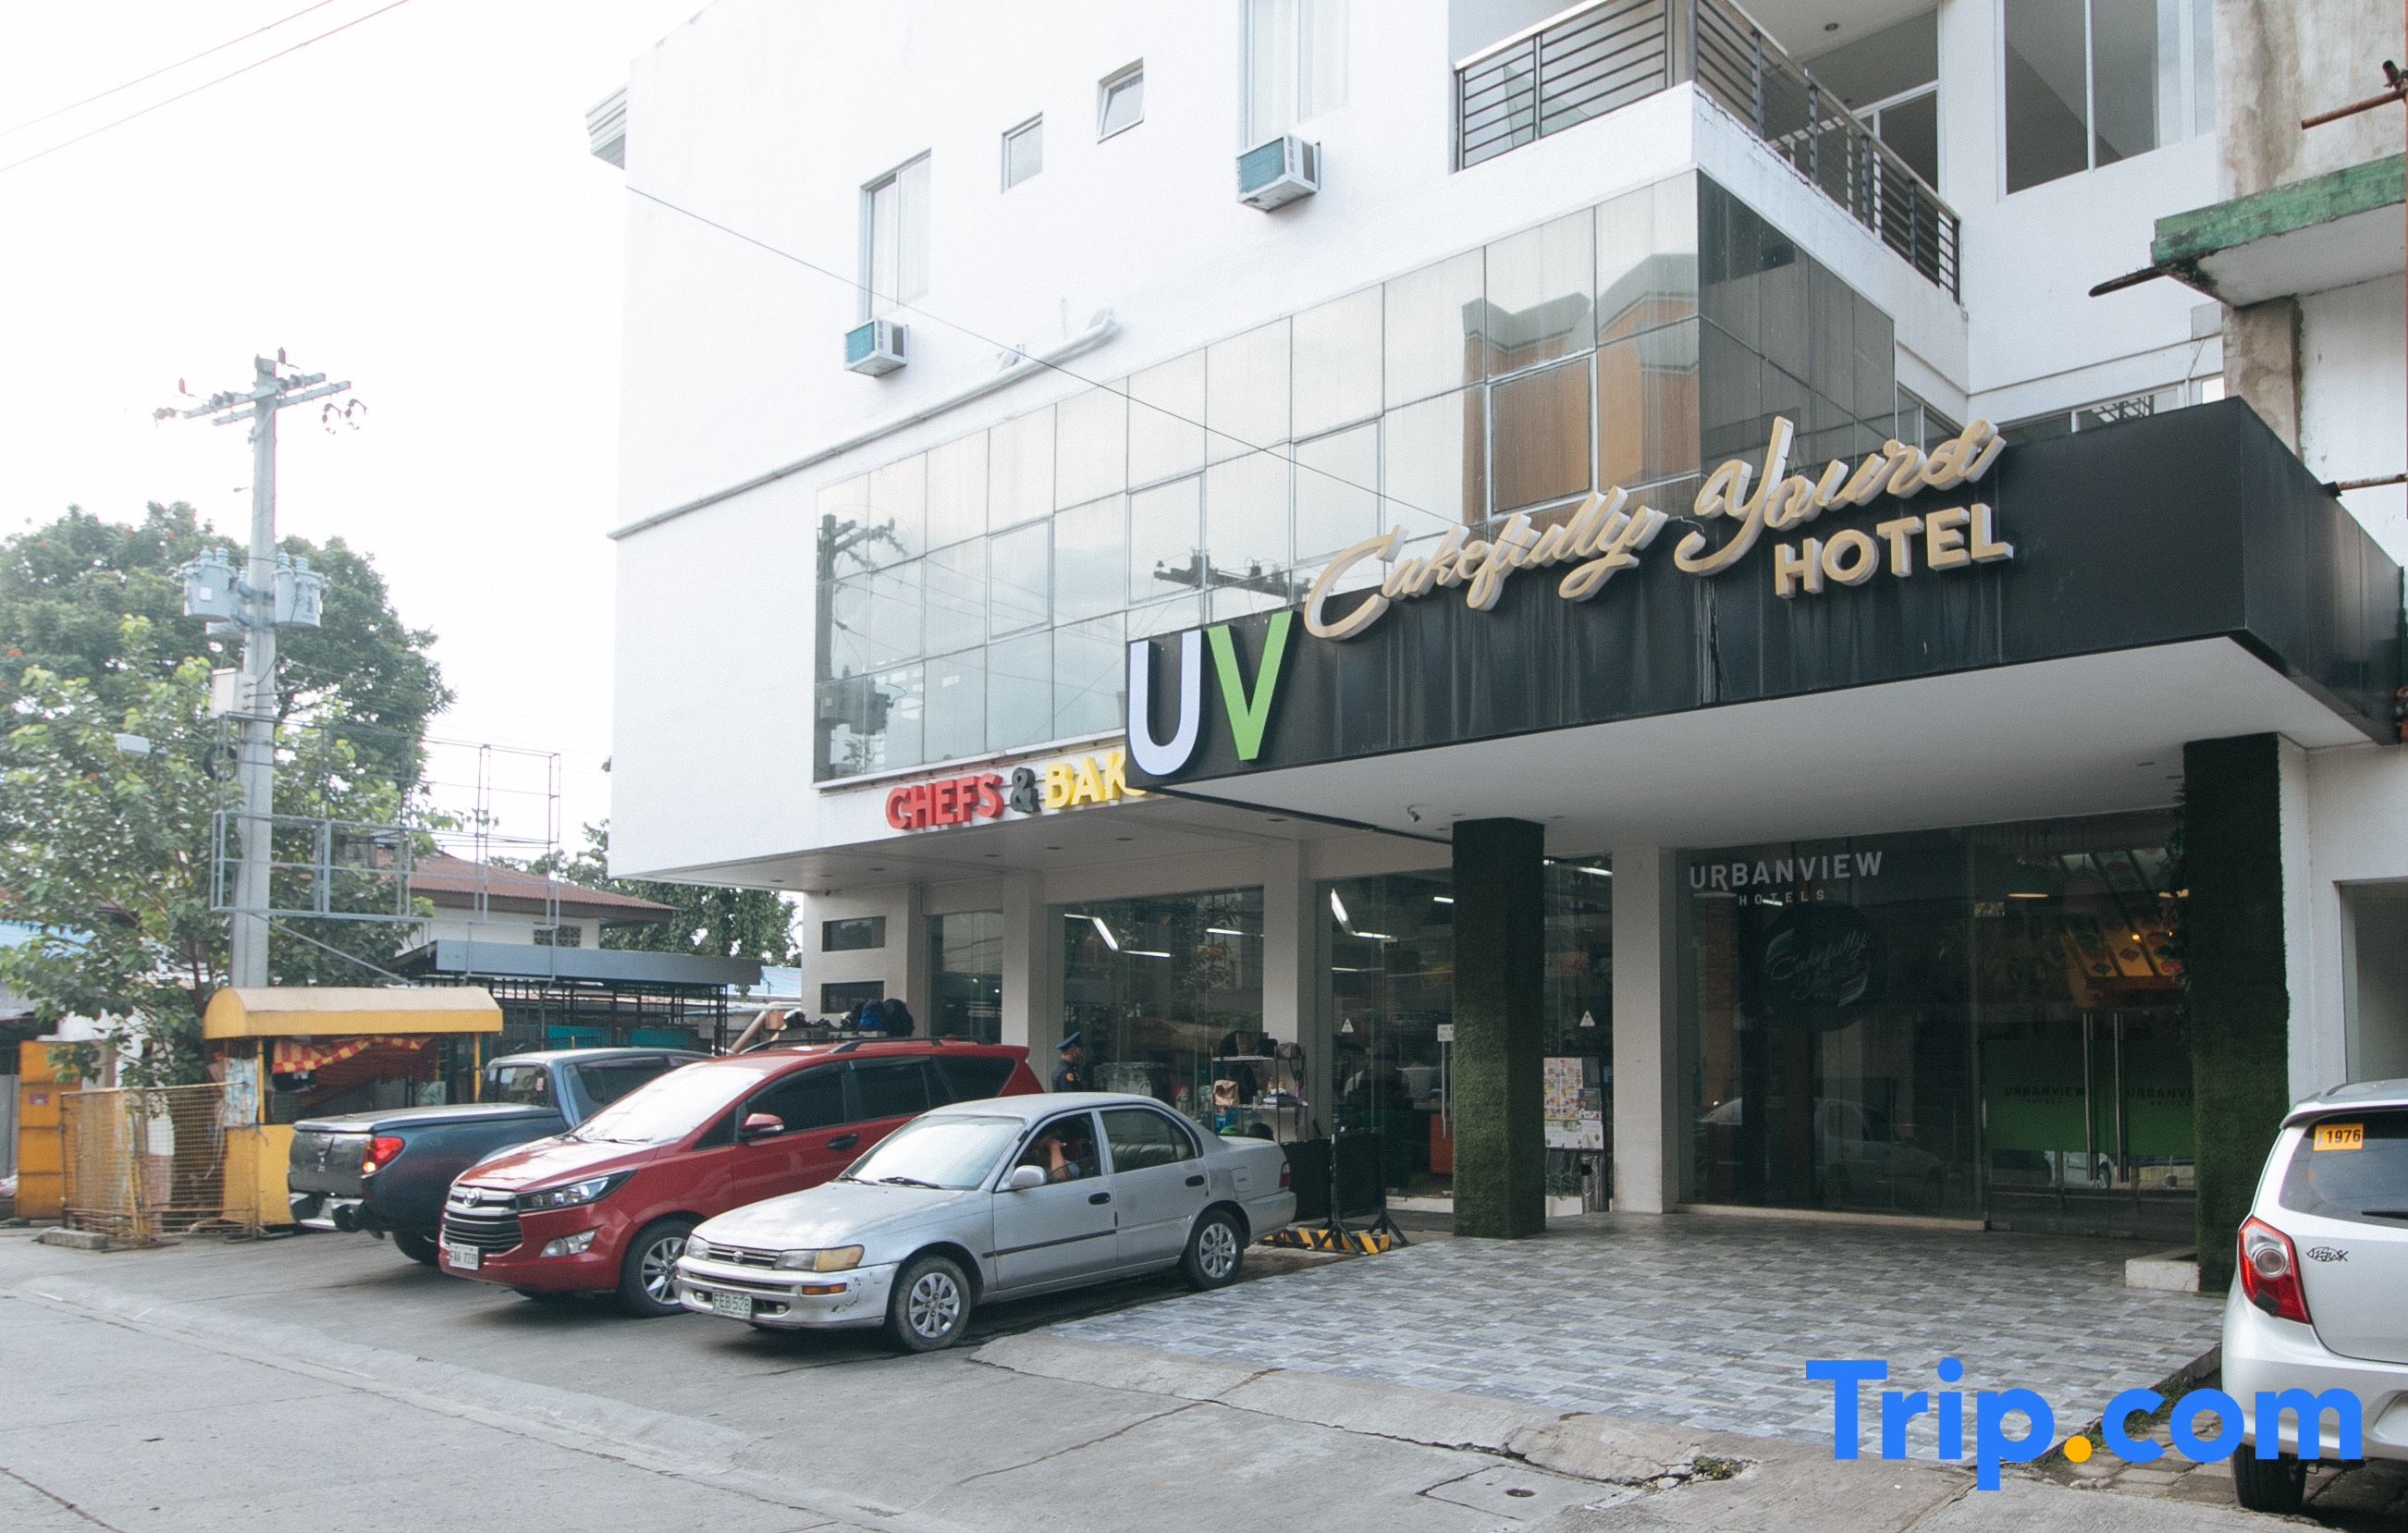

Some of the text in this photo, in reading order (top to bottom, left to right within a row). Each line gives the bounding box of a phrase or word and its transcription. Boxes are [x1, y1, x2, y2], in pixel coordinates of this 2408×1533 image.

[1303, 416, 2007, 642] Cakefully Yours
[1775, 503, 2014, 599] HOTEL
[1128, 611, 1294, 777] UV
[886, 773, 1005, 830] CHEFS
[1010, 766, 1041, 813] &
[1689, 851, 1883, 891] URBANVIEW
[1738, 889, 1825, 906] HOTELS
[2004, 1085, 2085, 1097] URBANVIEW
[2327, 1129, 2361, 1144] 1976
